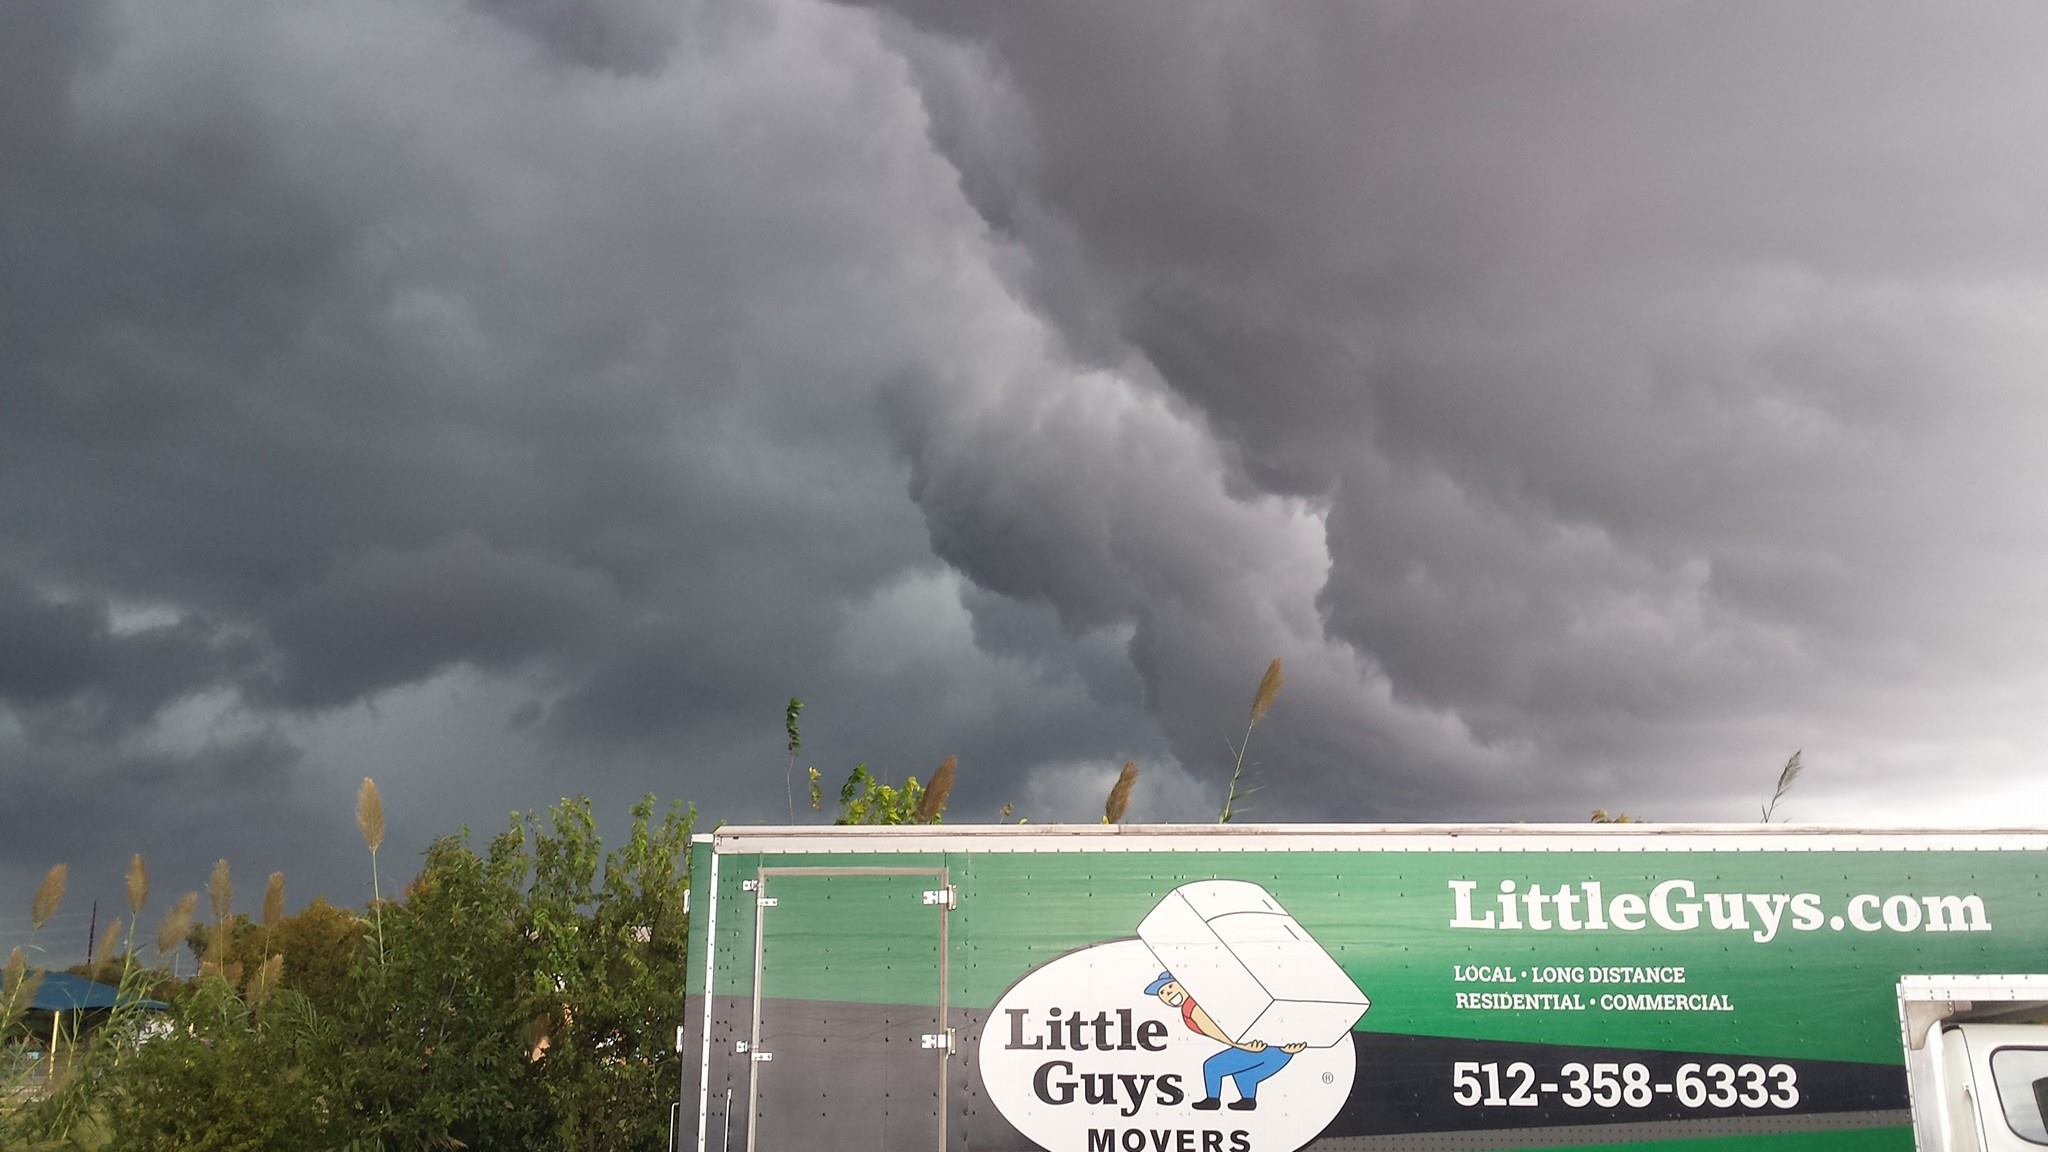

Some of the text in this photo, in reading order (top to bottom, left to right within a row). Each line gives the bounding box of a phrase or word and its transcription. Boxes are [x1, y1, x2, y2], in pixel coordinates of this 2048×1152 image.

[1448, 879, 1991, 942] LittleGuys.com
[1454, 965, 1686, 984] LOCAL LONG DISTANCE
[1455, 992, 1734, 1012] RESIDENTIAL COMMERCIAL
[1004, 1007, 1168, 1051] Little
[1033, 1060, 1184, 1117] Guys
[1452, 1061, 1800, 1109] 512-358-6333
[1088, 1128, 1251, 1152] MOVERS
